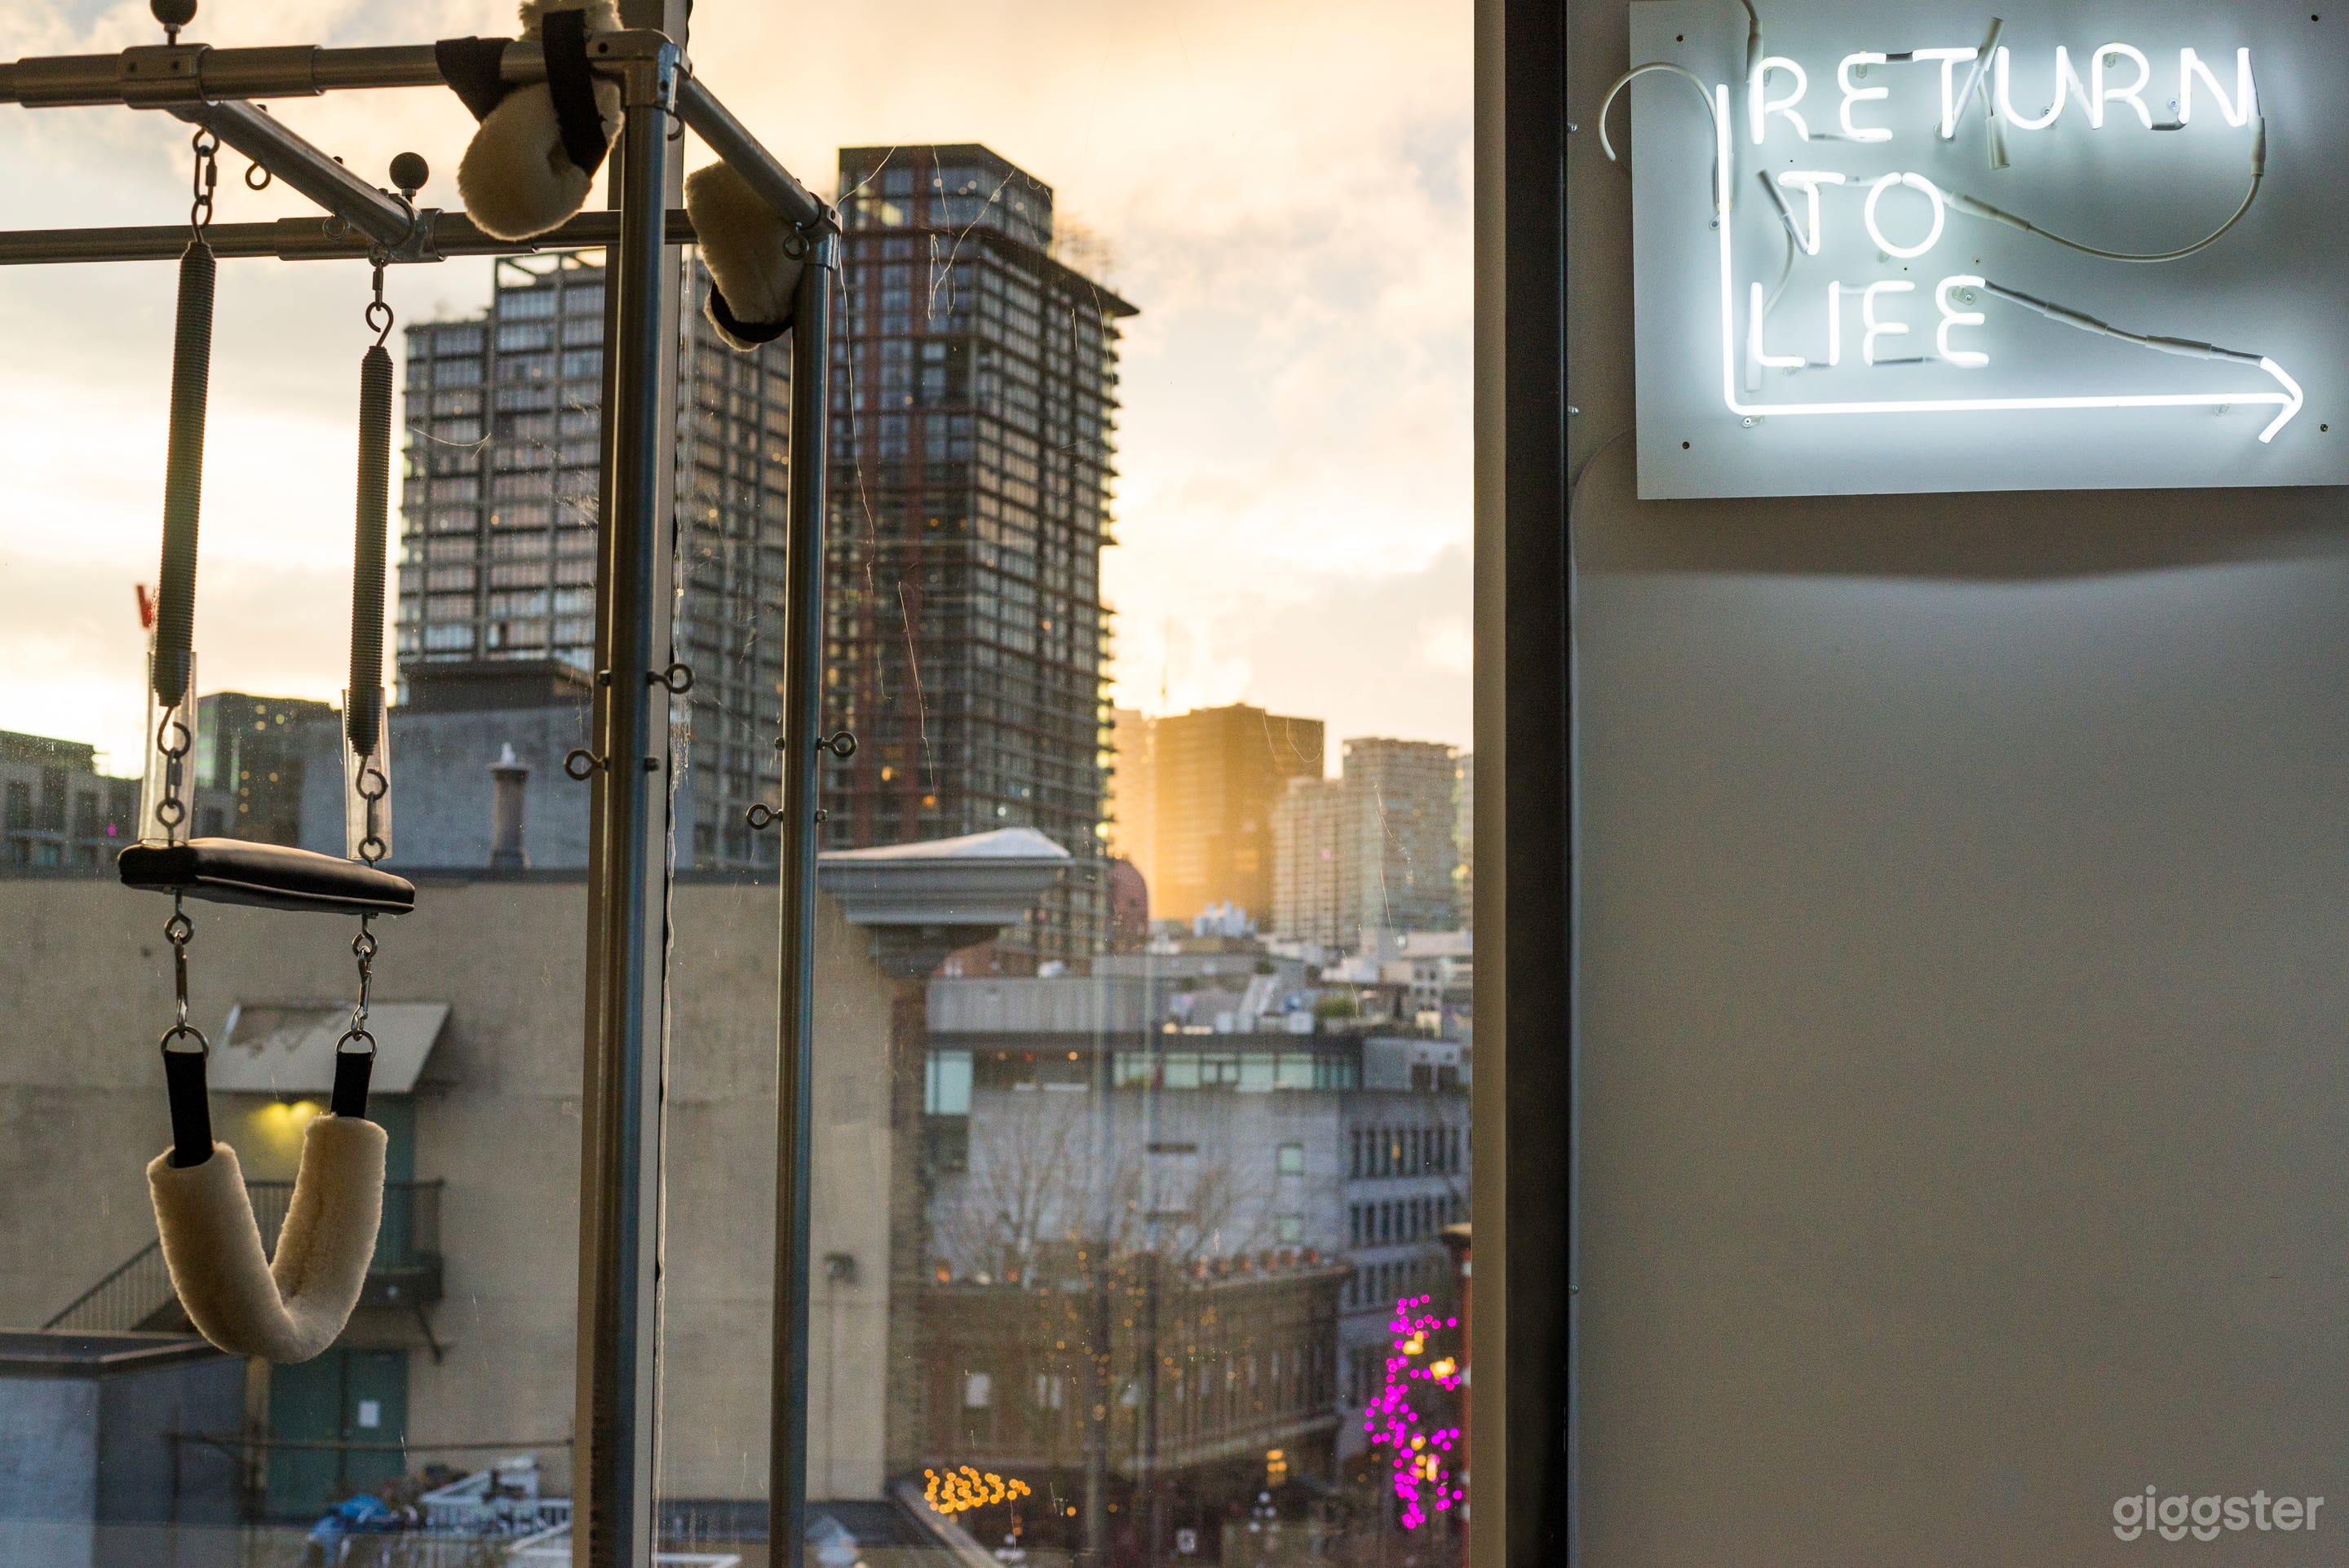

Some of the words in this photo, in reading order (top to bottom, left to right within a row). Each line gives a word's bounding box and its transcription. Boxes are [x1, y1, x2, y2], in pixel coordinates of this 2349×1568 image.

[1752, 42, 2250, 144] RETURN
[1777, 171, 1946, 258] TO
[1751, 276, 1989, 367] LIFE
